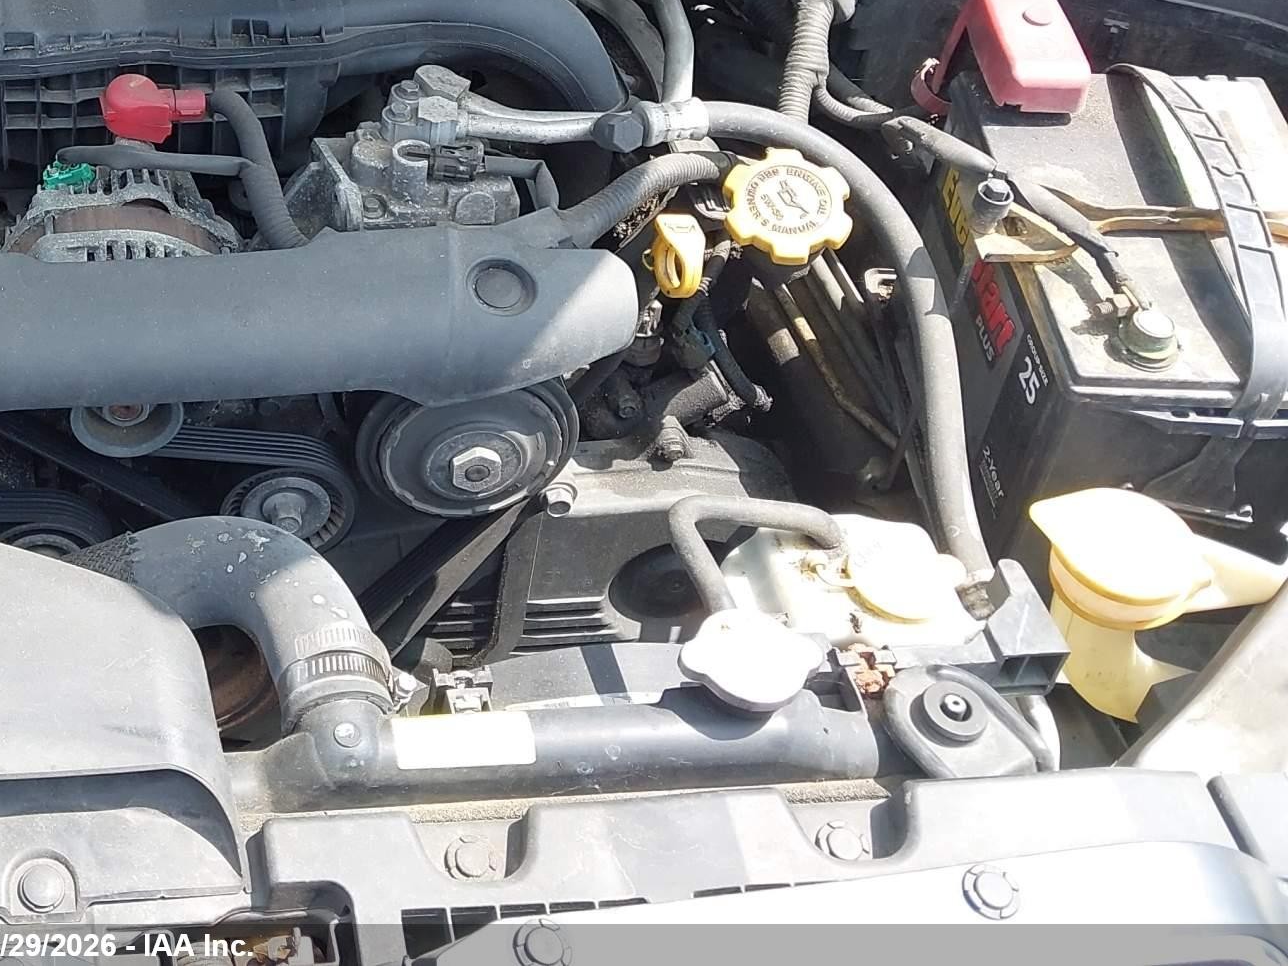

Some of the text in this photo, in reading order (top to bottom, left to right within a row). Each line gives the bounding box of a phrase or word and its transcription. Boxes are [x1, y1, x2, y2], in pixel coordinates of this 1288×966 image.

[786, 167, 828, 216] ENGINE OIL
[974, 313, 996, 362] PLUS
[1025, 333, 1049, 387] GROUP SIZE
[1017, 355, 1041, 405] 25
[982, 445, 1005, 497] 2-Year
